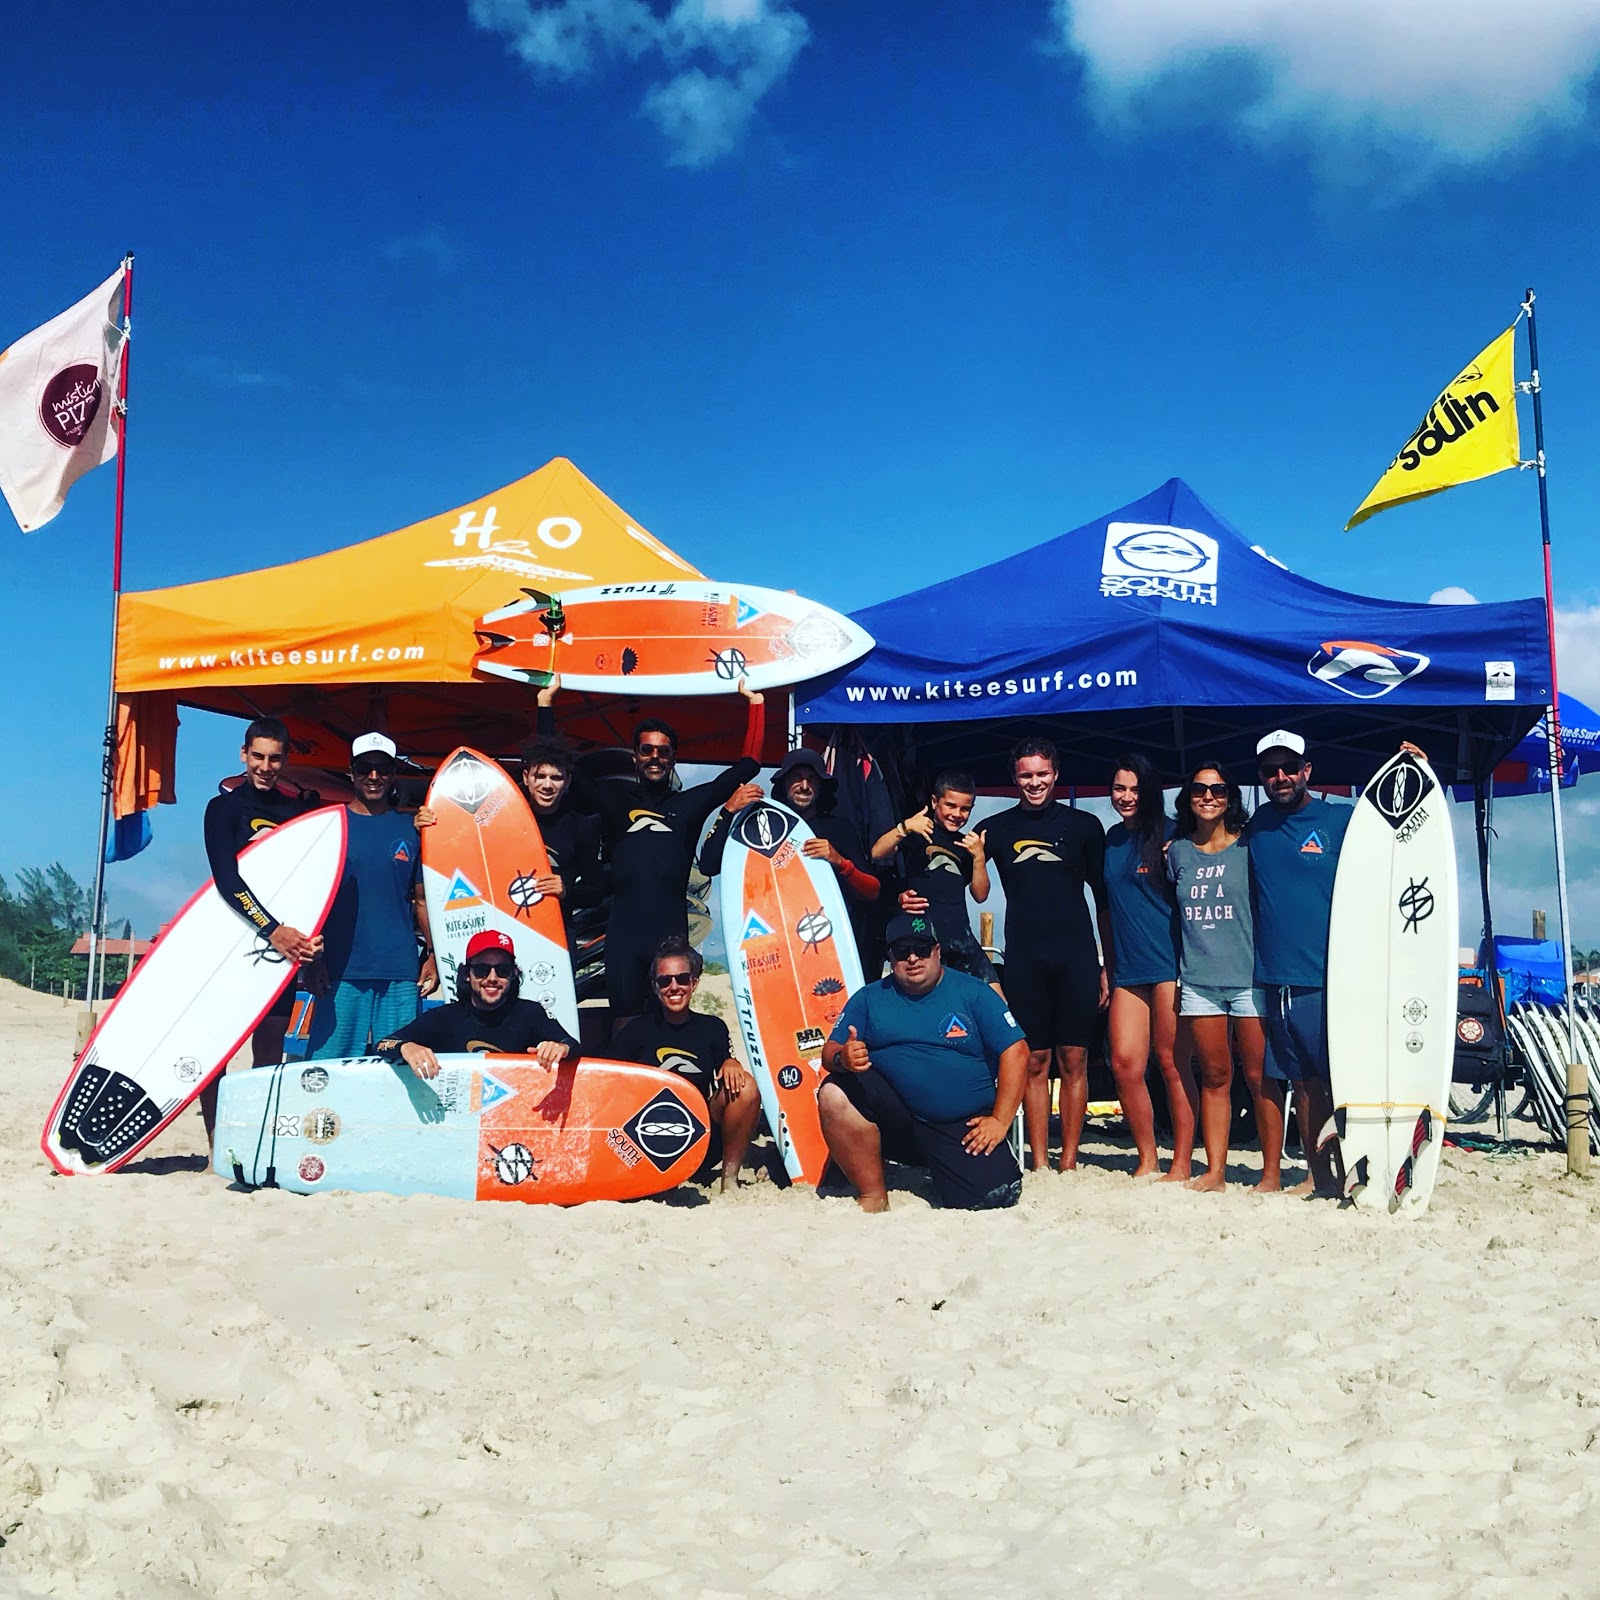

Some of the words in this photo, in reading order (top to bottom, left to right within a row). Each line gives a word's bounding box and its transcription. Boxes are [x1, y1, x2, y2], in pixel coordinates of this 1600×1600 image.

[1098, 588, 1133, 597] TO
[1136, 588, 1217, 606] SOUTH
[1100, 576, 1217, 599] SOUTH
[158, 642, 425, 671] www.kiteesurf.com
[845, 669, 1138, 702] www.kiteesurf.com
[1395, 806, 1427, 842] SOUTH
[1195, 864, 1226, 880] SUN
[1190, 884, 1209, 899] OF
[1215, 883, 1225, 898] A
[1184, 905, 1233, 920] BEACH
[445, 915, 486, 933] KITE&SURF
[741, 952, 781, 972] KITE&SURF
[608, 1128, 642, 1164] SOUTH
